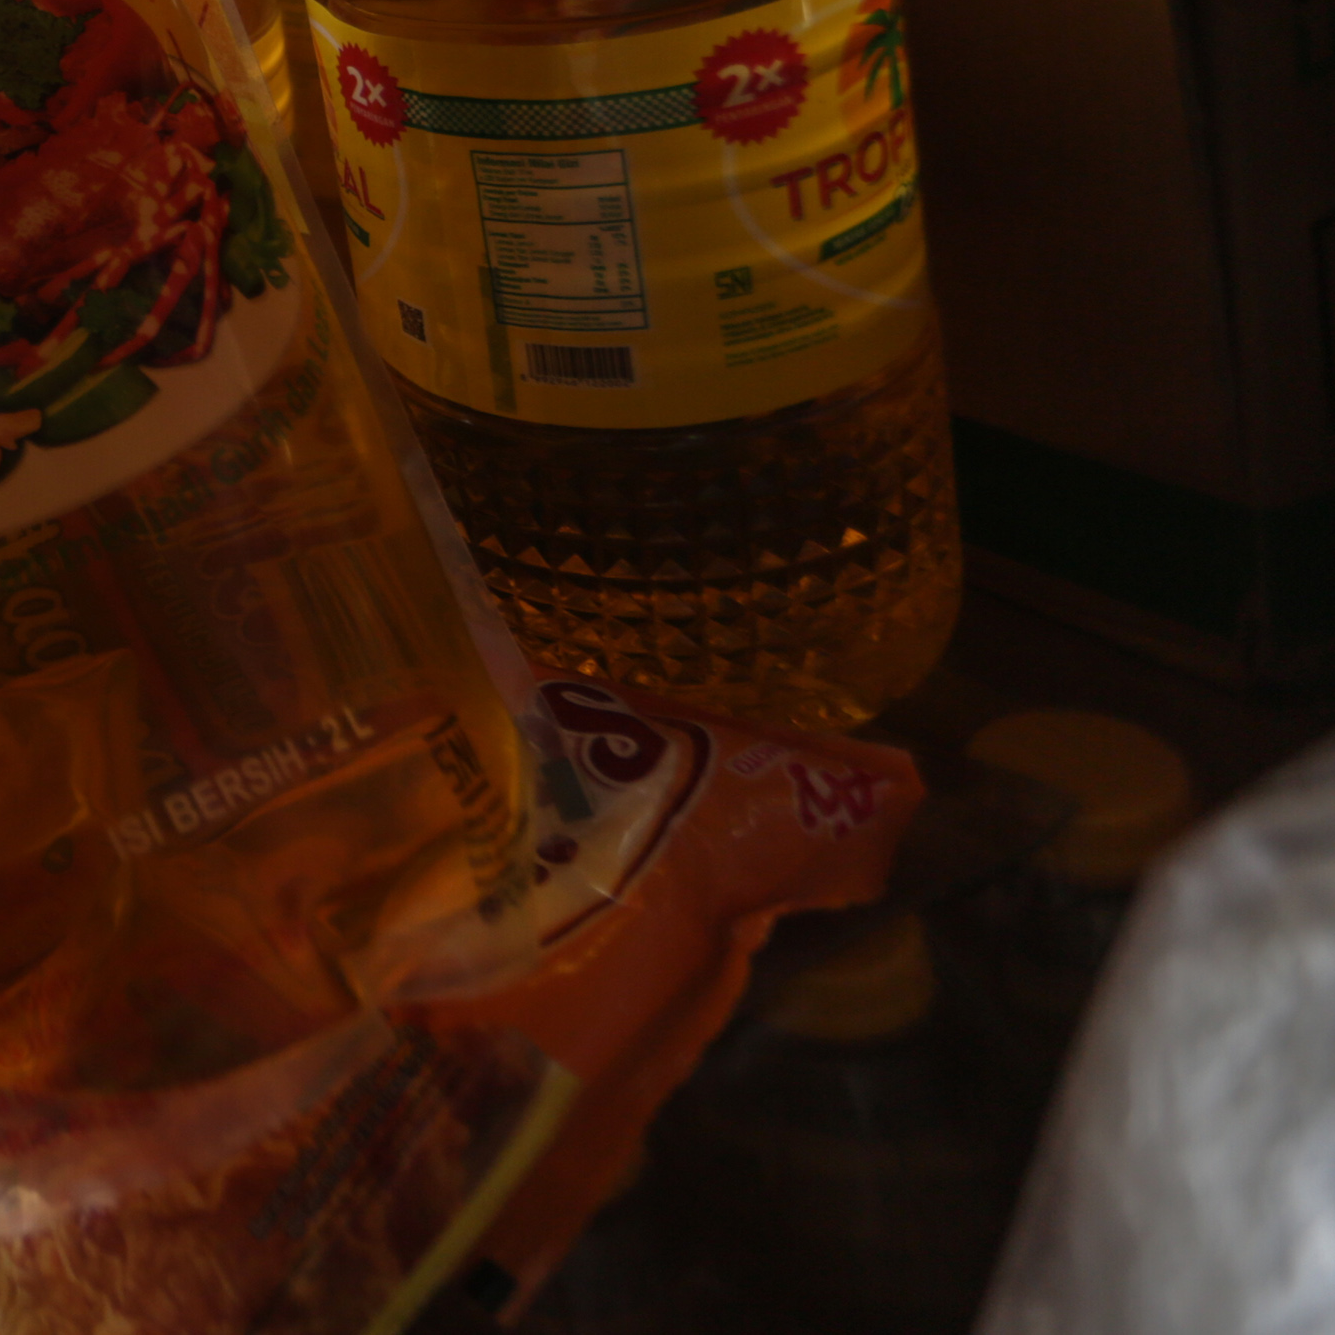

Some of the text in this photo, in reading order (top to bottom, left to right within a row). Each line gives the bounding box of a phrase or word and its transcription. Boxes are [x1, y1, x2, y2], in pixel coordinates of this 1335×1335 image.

[345, 65, 388, 108] 2x
[715, 58, 786, 109] 2x
[106, 807, 166, 863] ISI
[163, 735, 309, 835] BERSIH
